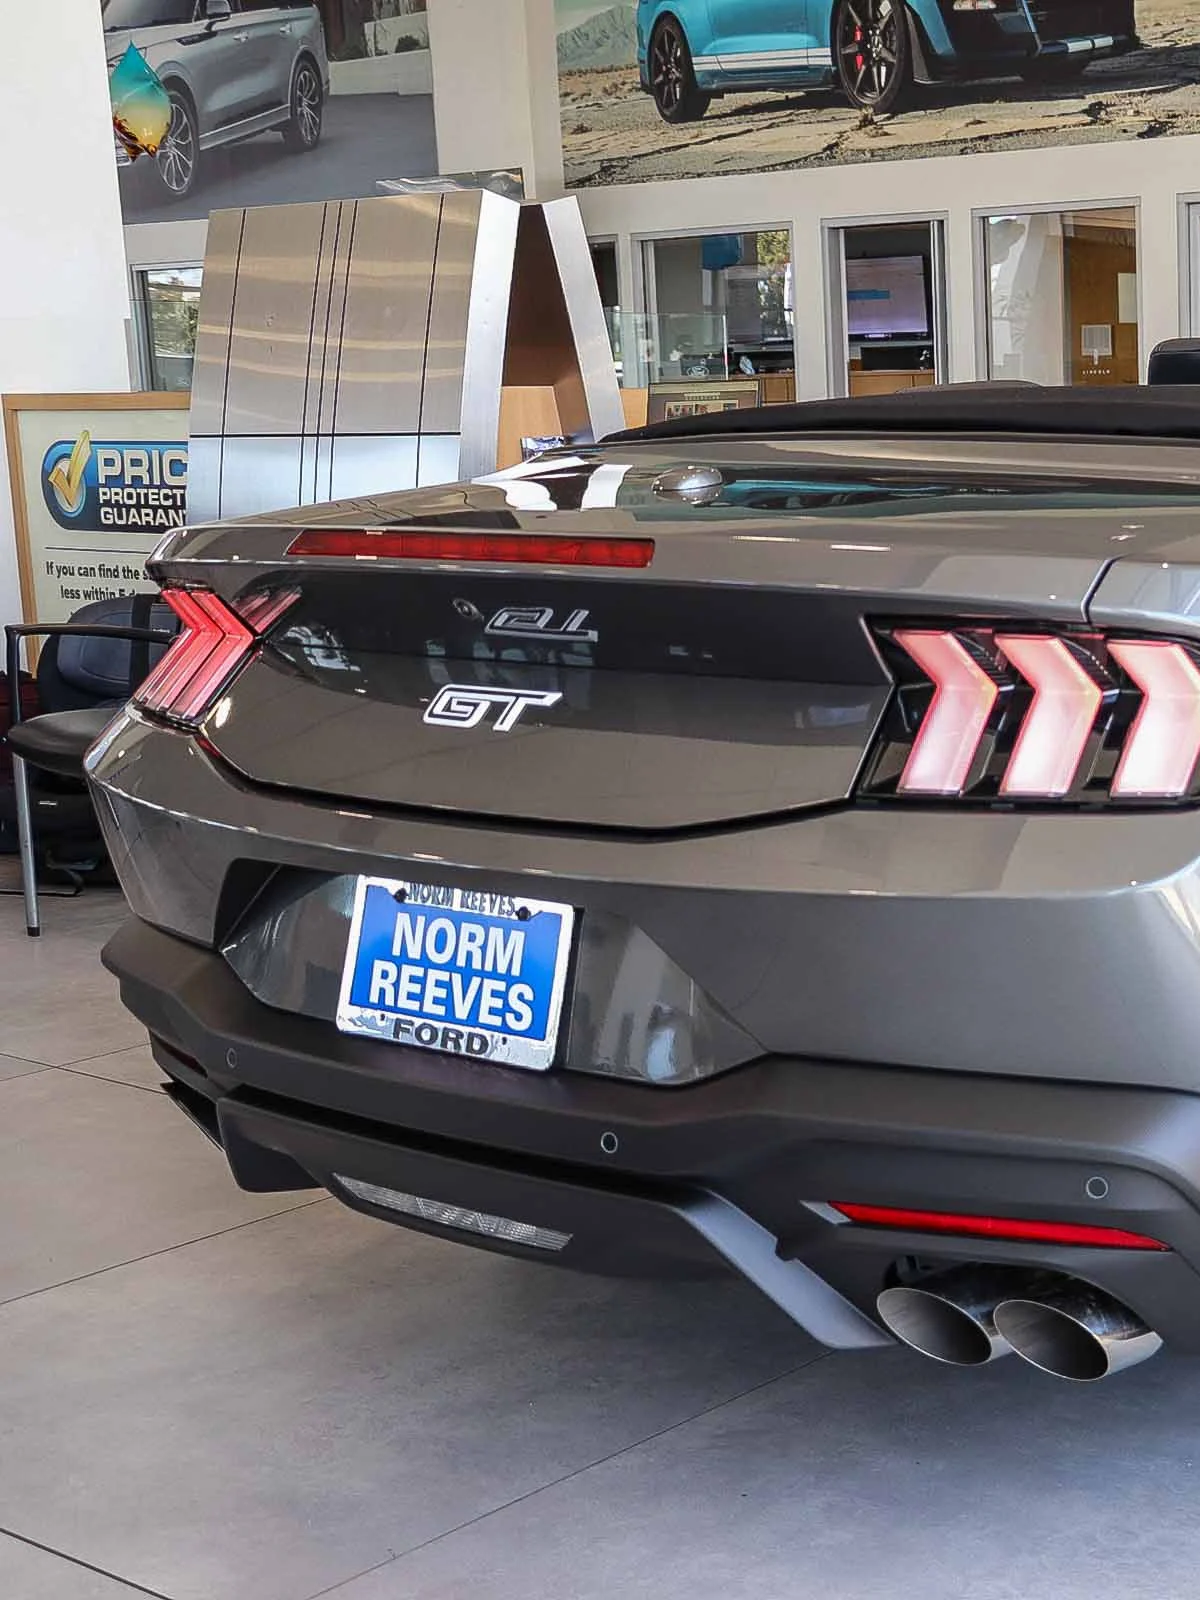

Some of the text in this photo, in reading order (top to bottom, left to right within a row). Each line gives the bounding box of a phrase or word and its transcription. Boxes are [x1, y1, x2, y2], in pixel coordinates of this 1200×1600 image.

[97, 449, 188, 486] PRIC
[98, 487, 186, 506] PROTECT
[100, 507, 188, 527] GUARAN
[46, 561, 54, 576] If
[56, 564, 75, 579] you
[78, 565, 97, 578] can
[98, 563, 120, 579] find
[122, 564, 141, 580] the
[60, 585, 81, 600] less
[83, 585, 116, 600] within
[423, 683, 563, 732] GT
[407, 882, 516, 917] NORM REEVES
[392, 912, 526, 977] NORM
[368, 959, 535, 1032] REEVES
[392, 1017, 492, 1056] FORD
